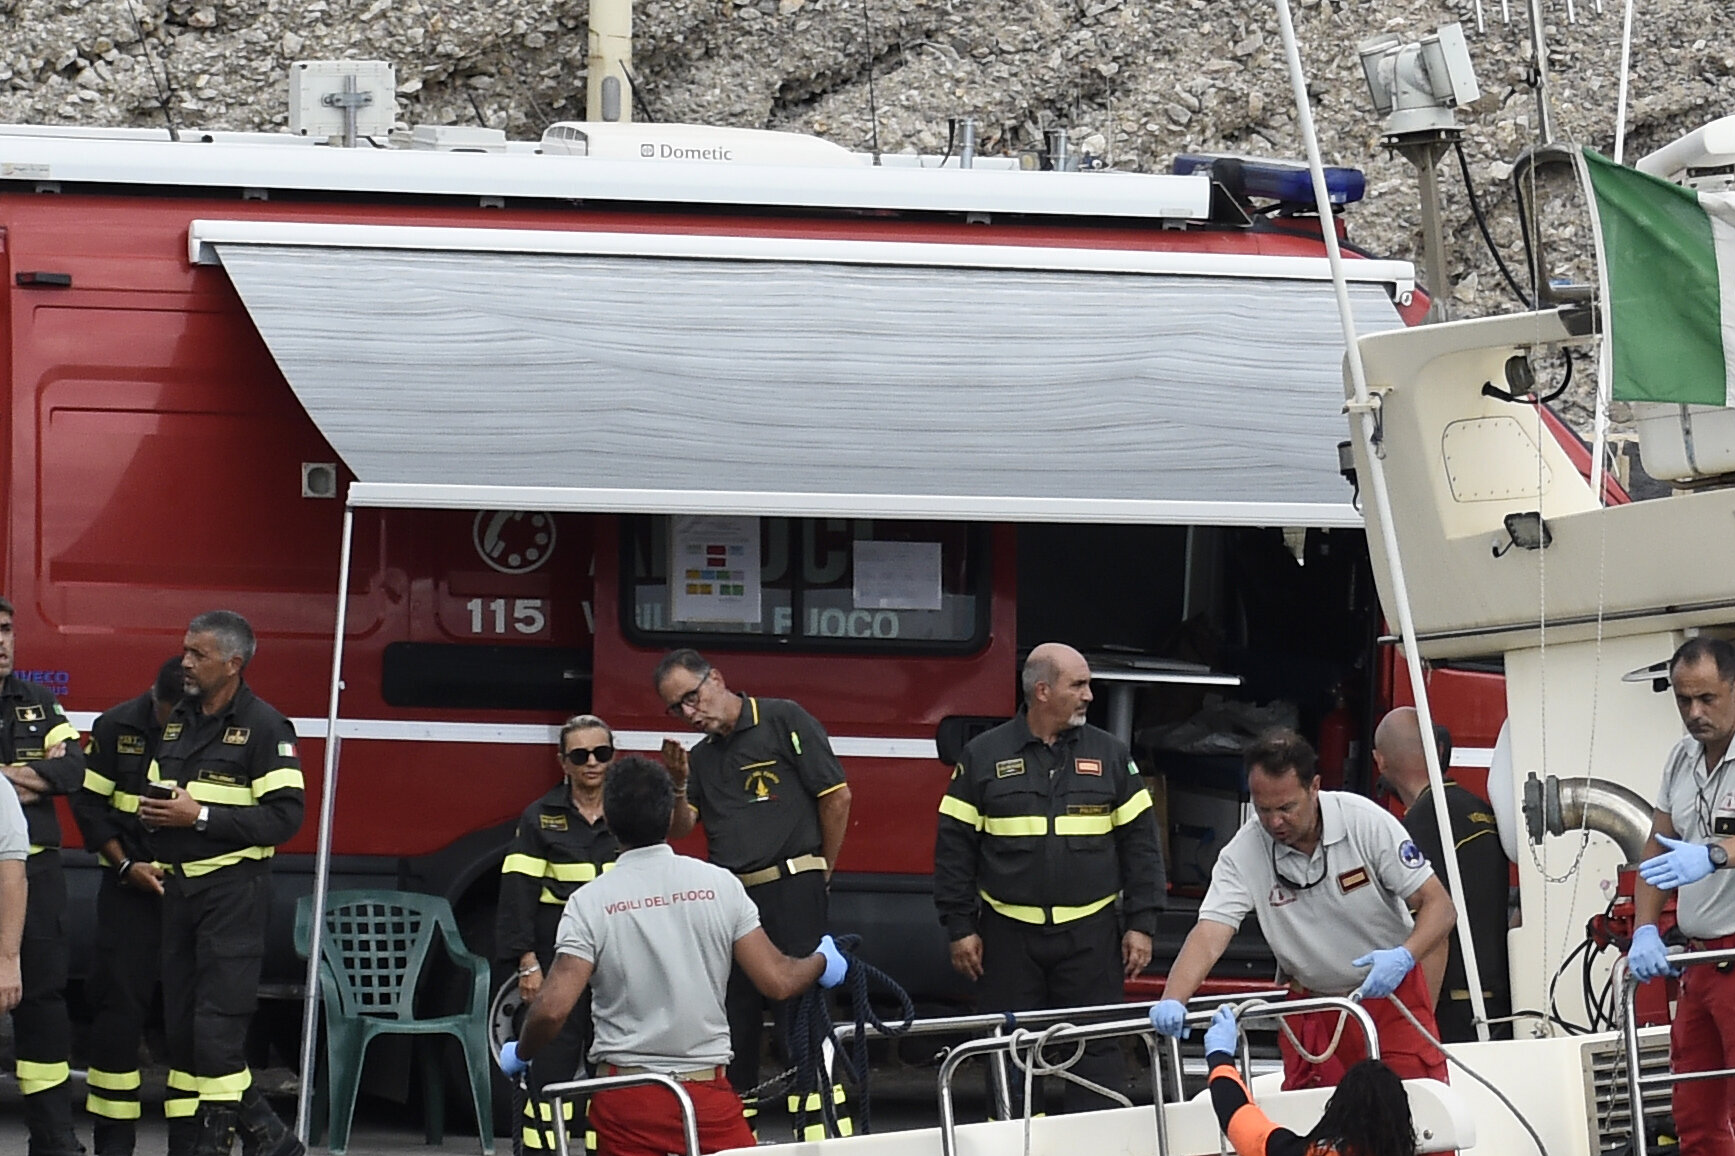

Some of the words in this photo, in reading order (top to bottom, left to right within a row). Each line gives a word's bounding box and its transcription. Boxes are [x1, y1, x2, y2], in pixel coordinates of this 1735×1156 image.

[660, 143, 734, 161] Dometic
[467, 598, 545, 634] 115
[604, 899, 642, 916] VIGILI
[644, 896, 670, 908] DEL
